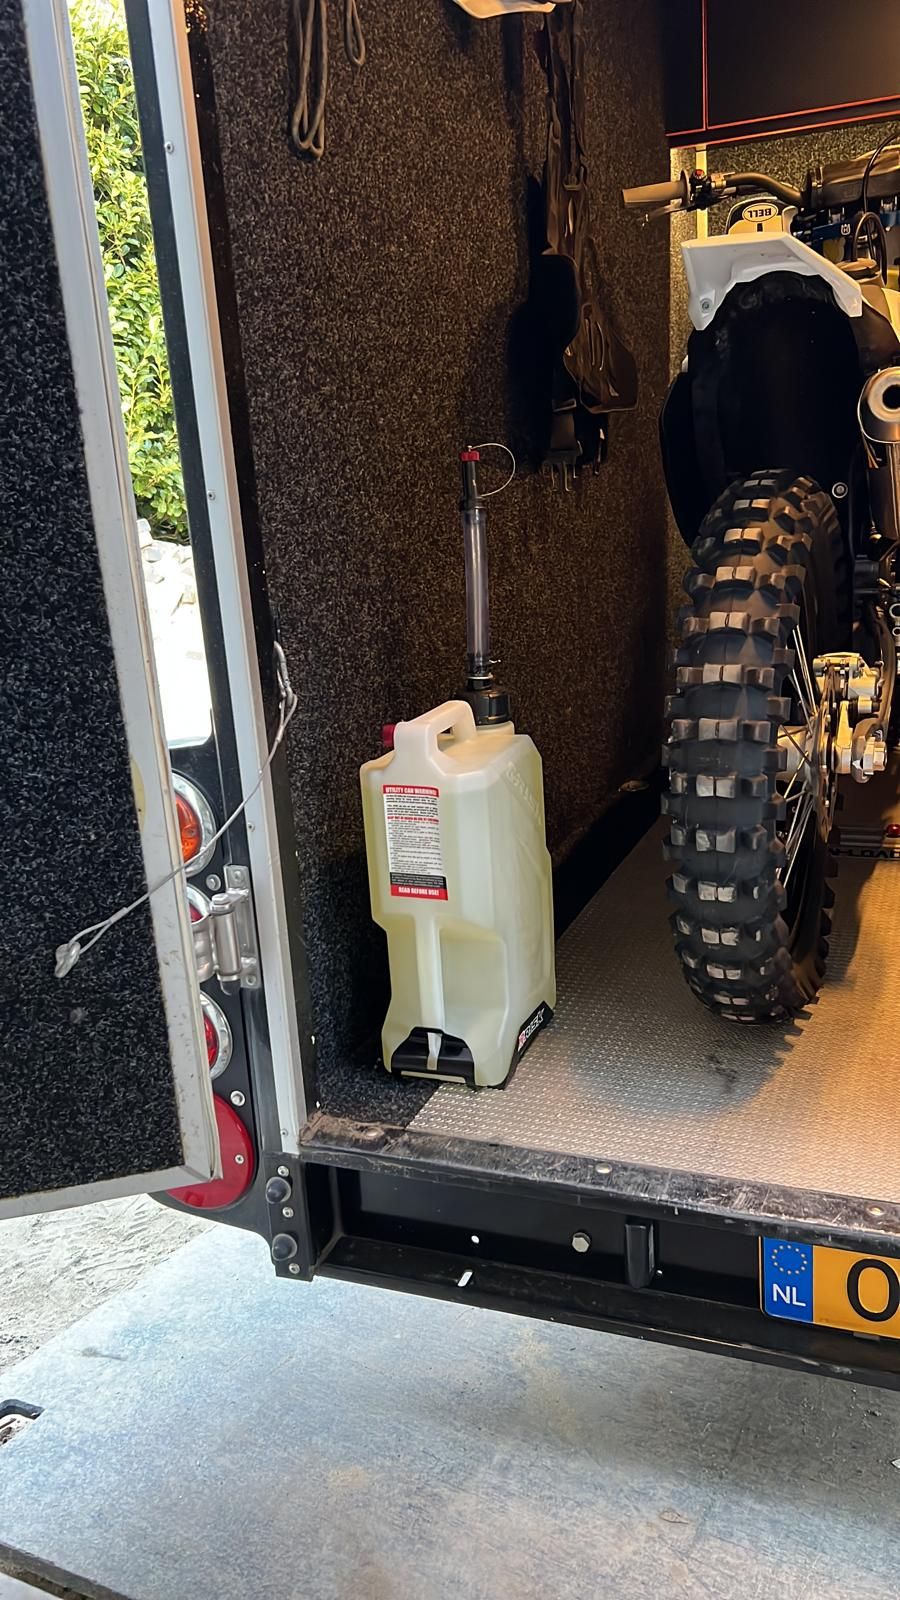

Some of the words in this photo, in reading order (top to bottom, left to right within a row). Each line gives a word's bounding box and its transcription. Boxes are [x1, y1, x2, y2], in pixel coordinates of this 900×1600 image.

[747, 208, 772, 218] BELL
[772, 1283, 806, 1307] NL
[846, 1258, 900, 1322] O
